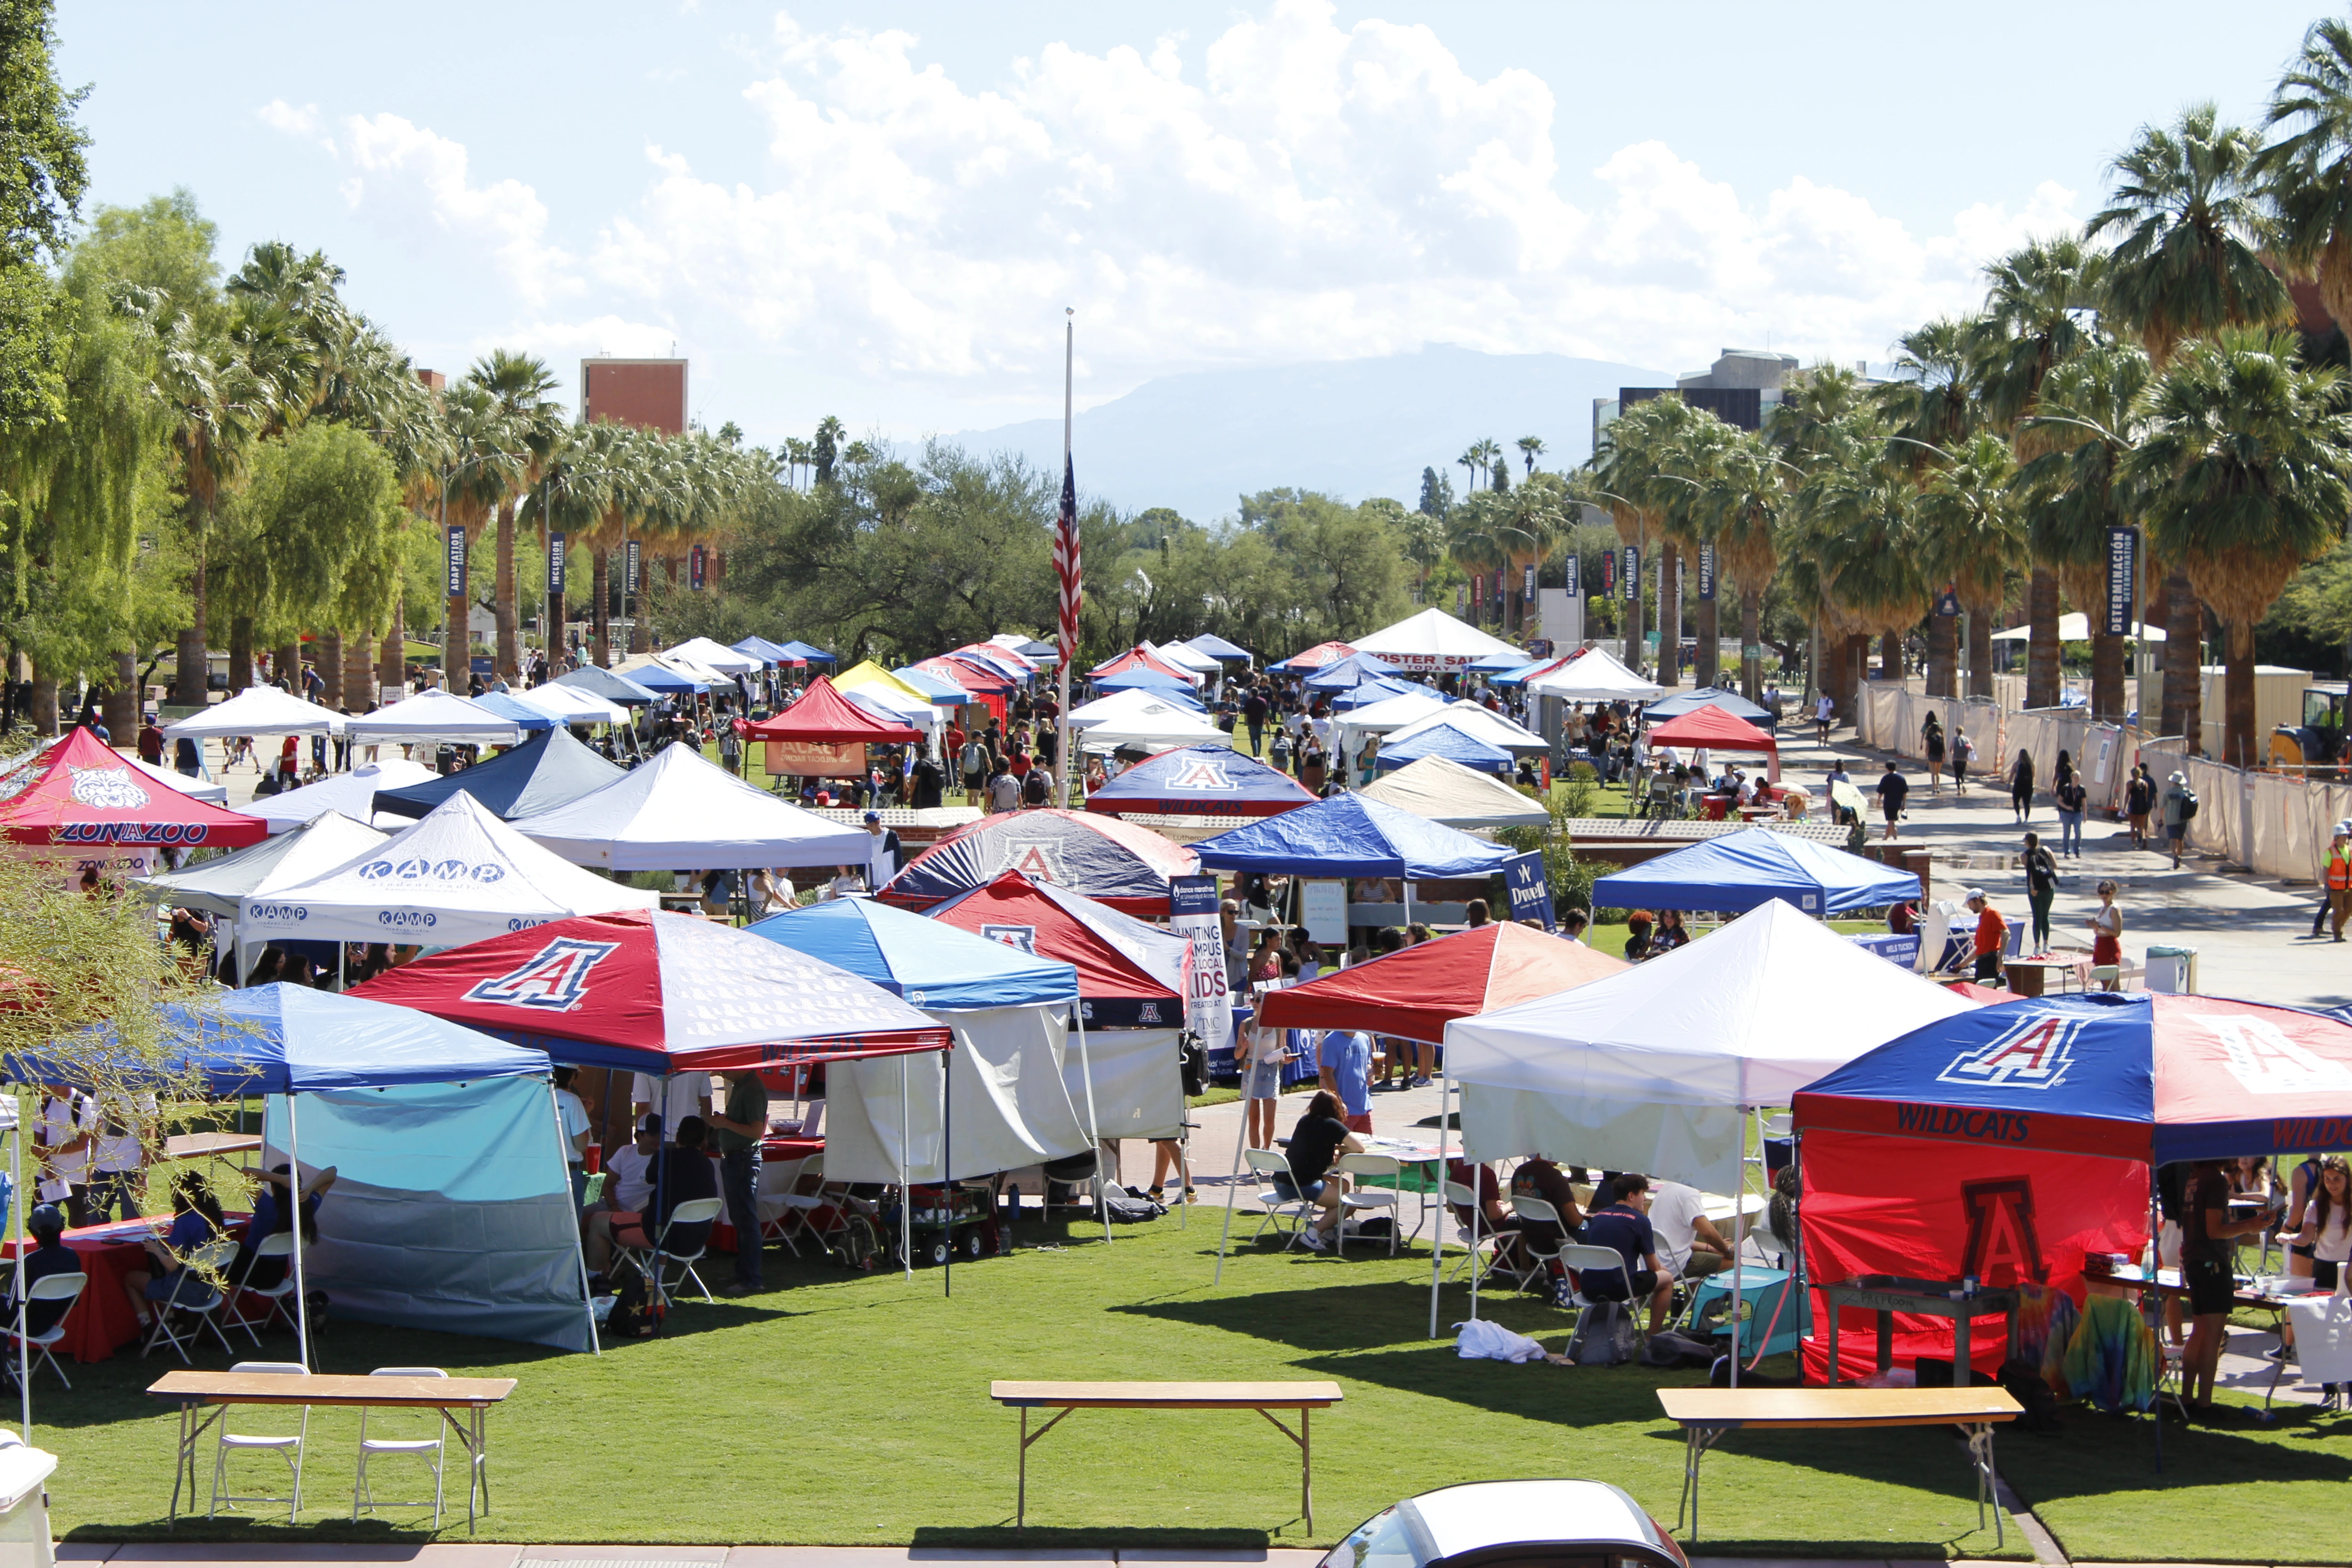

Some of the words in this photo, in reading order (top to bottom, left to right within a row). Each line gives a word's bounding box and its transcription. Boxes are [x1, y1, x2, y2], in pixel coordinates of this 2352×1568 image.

[451, 533, 459, 591] ADAPTATION
[2123, 535, 2132, 603] DETERMINATION
[1625, 549, 1633, 598] EXPLORACIÓN
[2111, 533, 2124, 632] DETERMINACIÓN
[1369, 654, 1436, 665] OSTER
[1445, 655, 1487, 666] SAL
[1158, 800, 1244, 813] WILDCATS
[363, 856, 501, 883] KAMP
[1511, 880, 1546, 905] Dwell
[251, 903, 306, 920] KAMP
[380, 908, 435, 926] KAMP
[1192, 942, 1221, 957] MPUS
[1898, 942, 1915, 951] TUCSON
[1198, 958, 1224, 970] LOCAL
[1191, 971, 1226, 998] IDS
[1200, 1017, 1220, 1030] TMC
[1897, 1102, 2030, 1142] WILDCATS
[1861, 1292, 1916, 1309] PREPROOM
